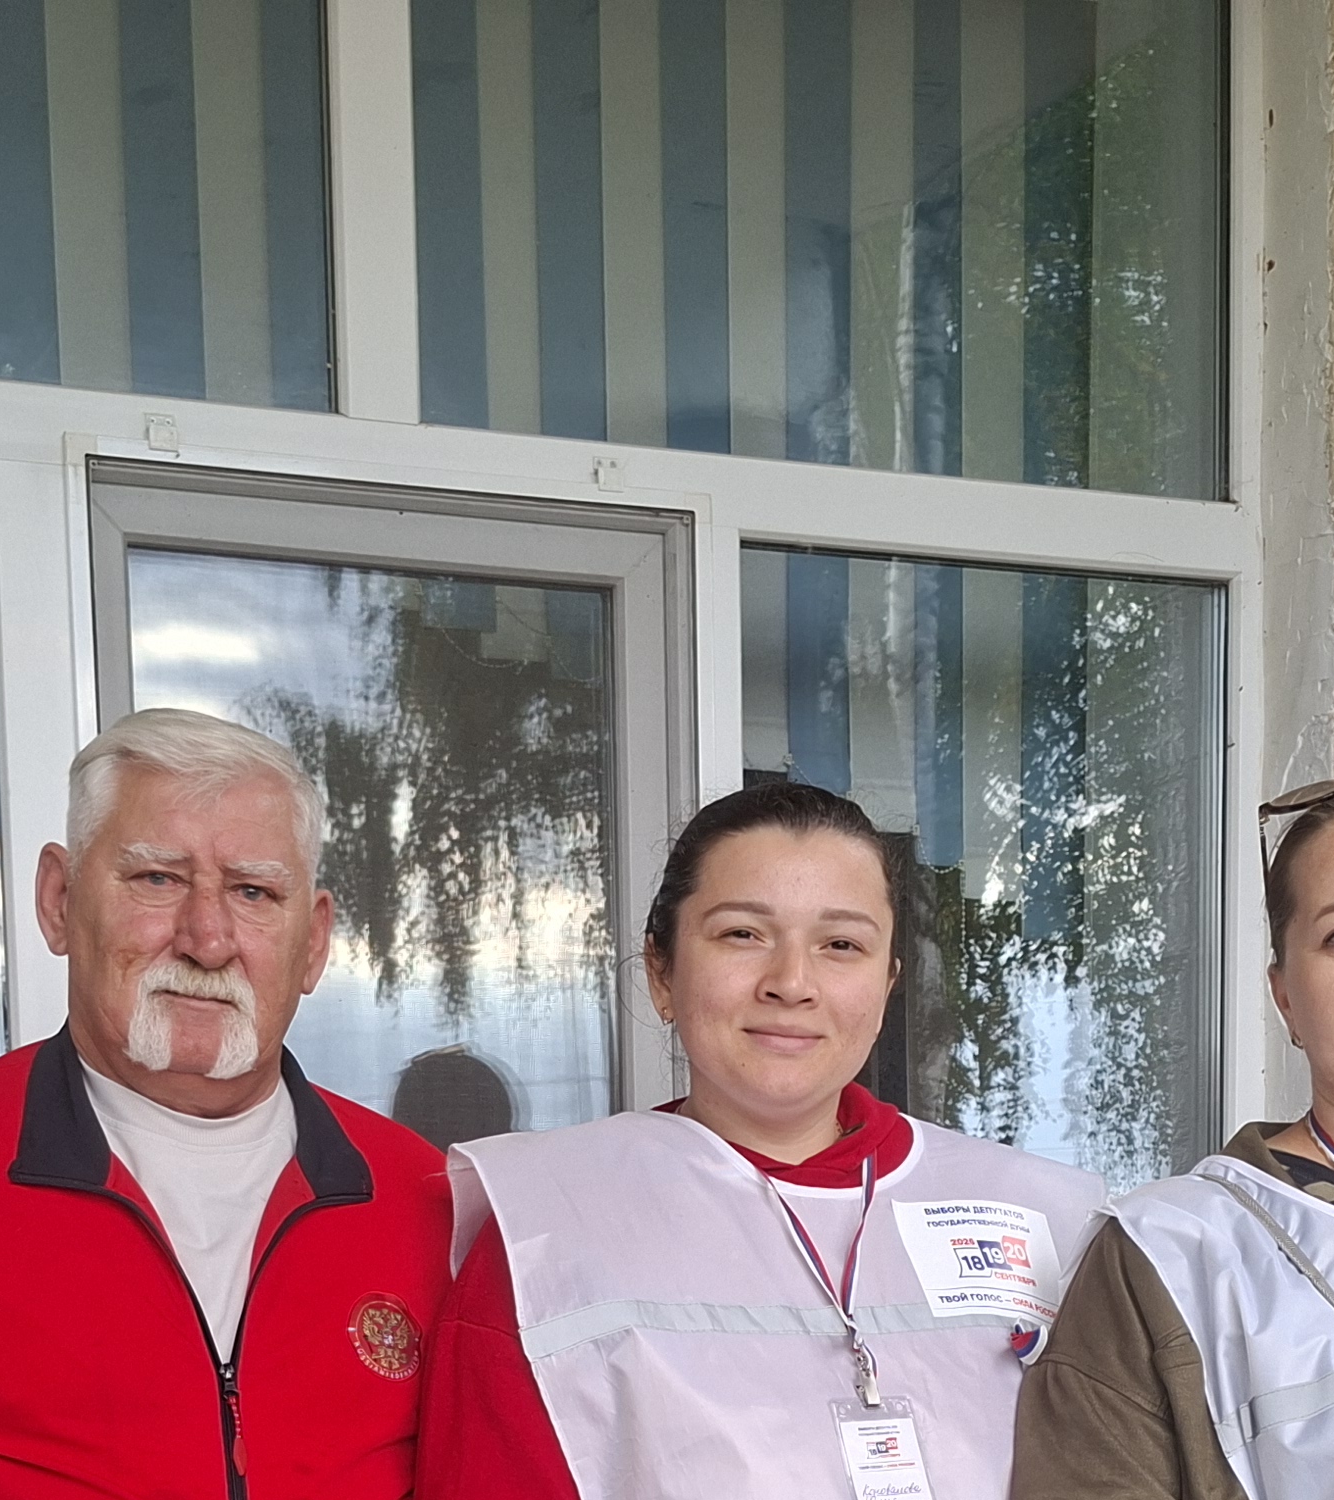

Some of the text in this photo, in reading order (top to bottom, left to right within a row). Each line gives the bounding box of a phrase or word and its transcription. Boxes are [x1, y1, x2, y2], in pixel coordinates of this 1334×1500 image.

[924, 1206, 1025, 1220] ВЫБОРЫ ДЕПУТАТОВ
[927, 1219, 1008, 1228] ГОСУДАРСТВЕННОЙ
[950, 1238, 975, 1246] 2026
[961, 1242, 1026, 1271] 18 19 20
[938, 1293, 968, 1303] ТВОЙ
[970, 1293, 1003, 1303] ГОЛОС
